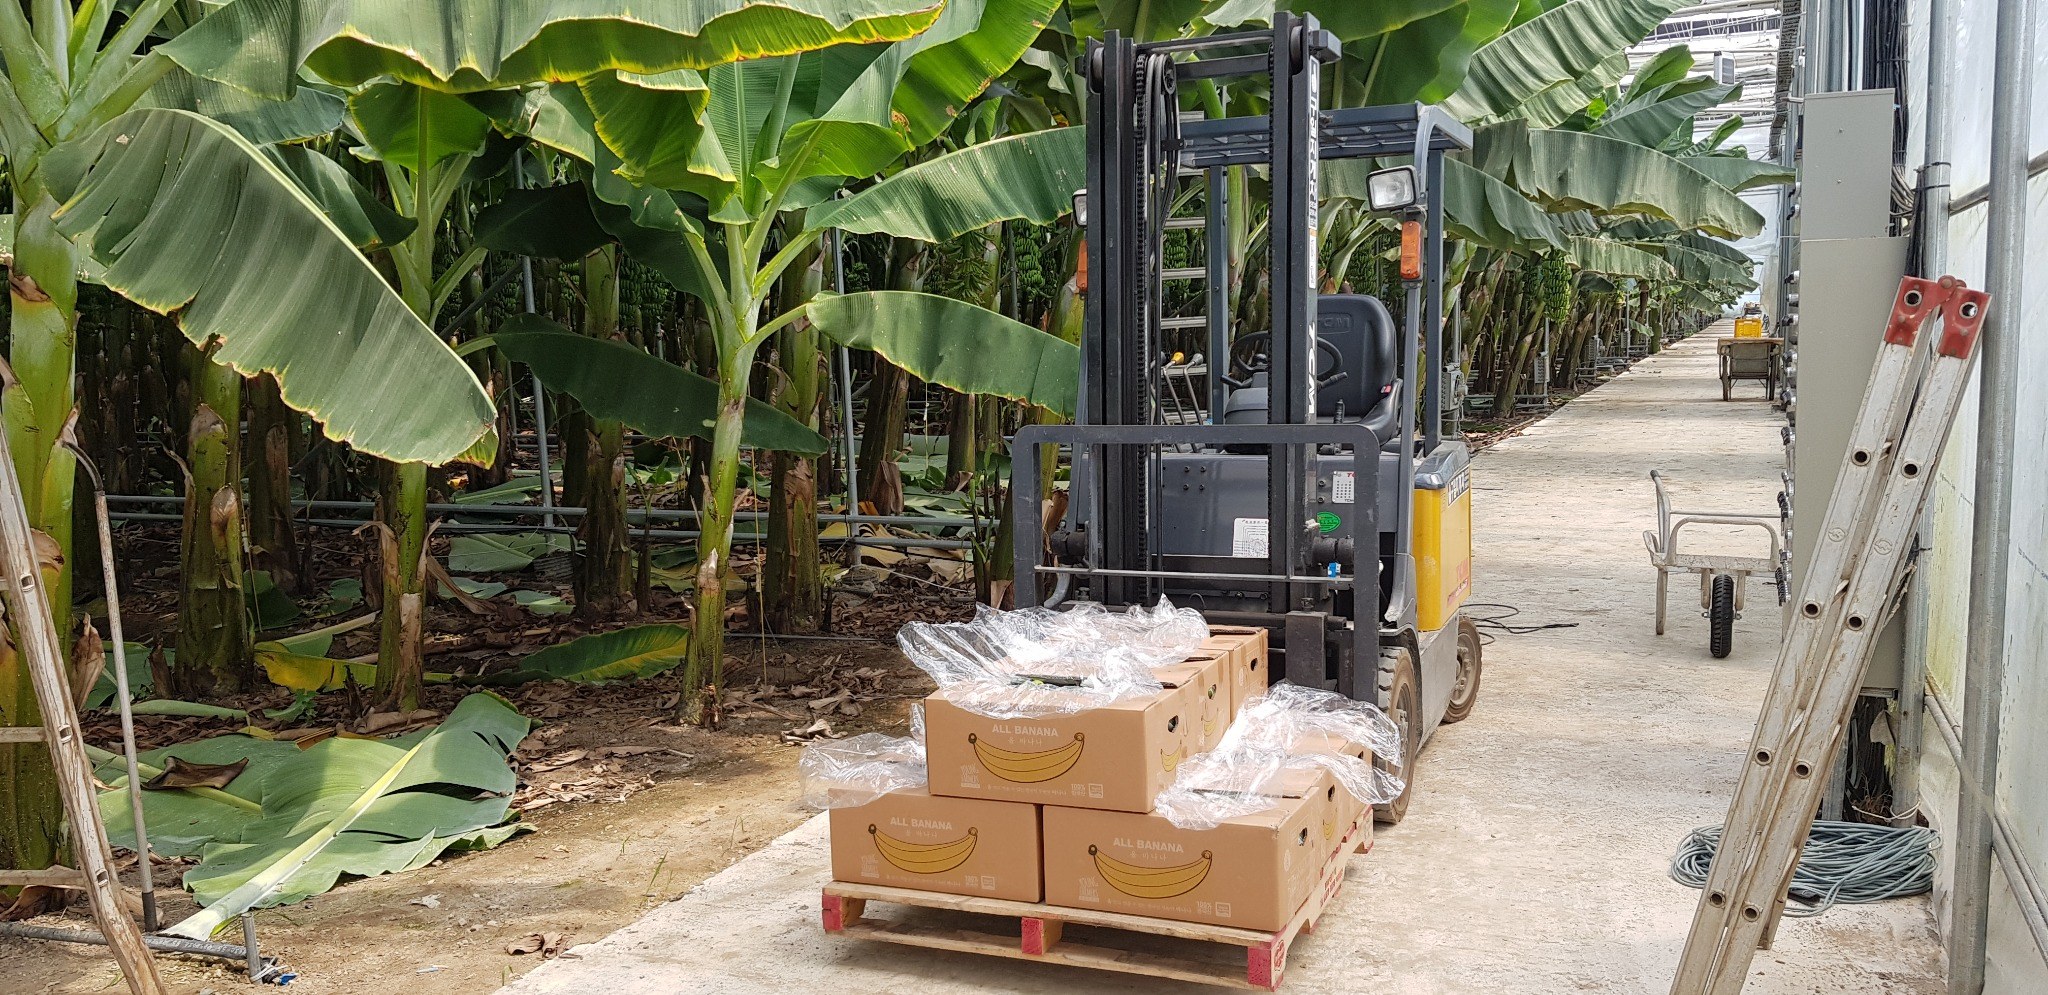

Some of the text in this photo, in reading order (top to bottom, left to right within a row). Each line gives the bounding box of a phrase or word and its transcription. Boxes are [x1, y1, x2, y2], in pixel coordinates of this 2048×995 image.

[1308, 321, 1316, 413] TCM
[992, 724, 1059, 737] ALL BANANA
[890, 817, 953, 830] ALL BANANA
[1113, 838, 1184, 853] ALL BANANA
